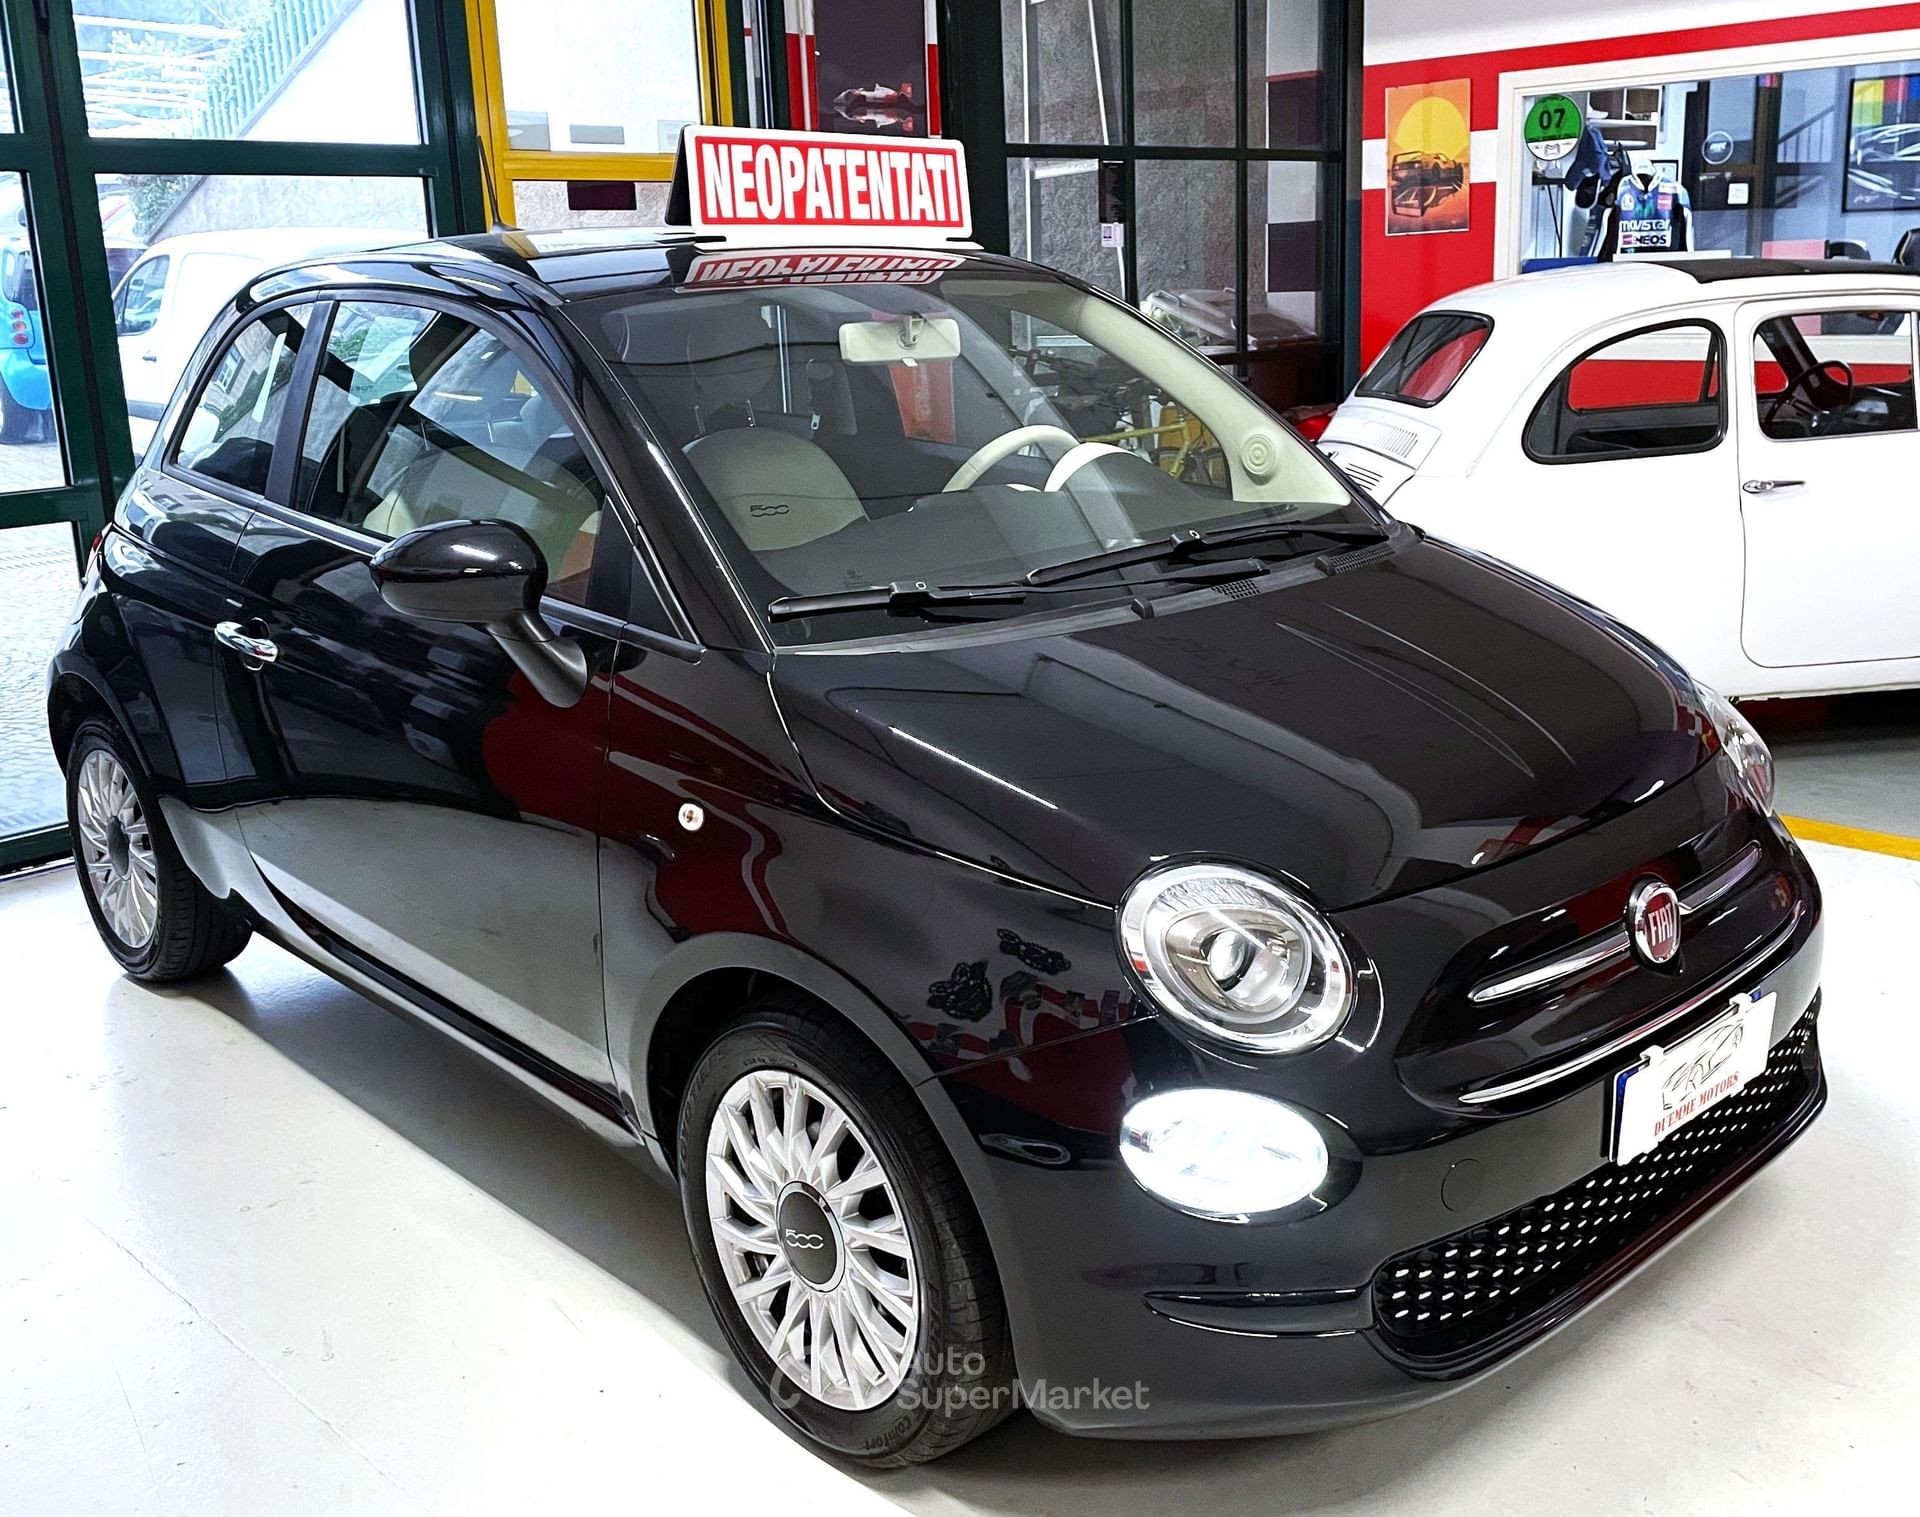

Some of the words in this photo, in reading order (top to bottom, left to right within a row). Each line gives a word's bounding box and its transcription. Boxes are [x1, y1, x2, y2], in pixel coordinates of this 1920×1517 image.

[1539, 108, 1566, 130] 07
[702, 143, 960, 222] NEOPATENTATI
[750, 504, 790, 517] 500
[1648, 902, 1674, 946] FIAT
[1698, 1071, 1740, 1107] MOTORS
[785, 1228, 824, 1250] 500
